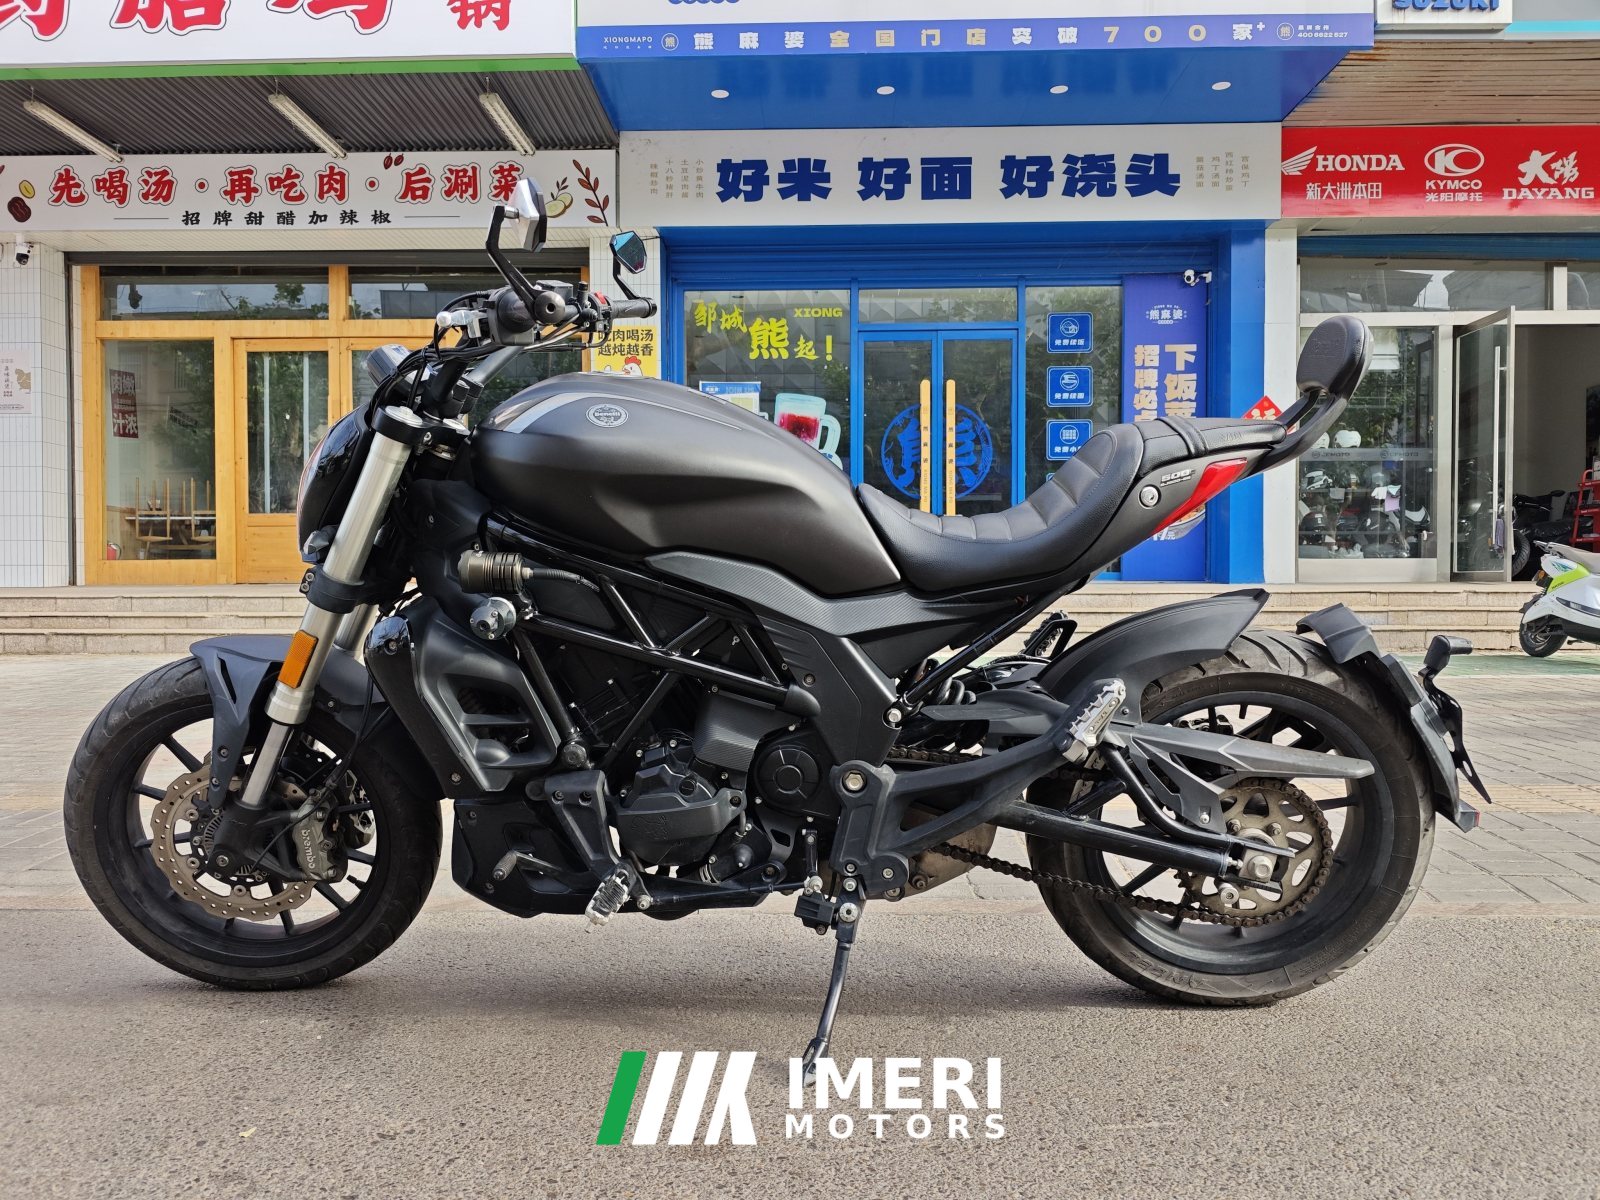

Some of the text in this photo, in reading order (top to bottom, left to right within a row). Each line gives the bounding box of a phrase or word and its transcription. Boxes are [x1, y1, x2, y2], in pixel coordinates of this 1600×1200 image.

[1316, 154, 1405, 172] HONDA
[716, 152, 1180, 203] 好米 好面 好浇头
[1425, 179, 1483, 190] KYMCO
[1306, 182, 1382, 200] 新大洲本田
[1425, 192, 1483, 202] 光阳摩托
[1502, 187, 1595, 200] DAYANG
[182, 209, 392, 226] 招牌甜醋加辣椒
[794, 307, 842, 318] XIONG
[598, 343, 654, 356] 越炖越香
[113, 412, 138, 434] 汁浓
[301, 829, 316, 869] brembo
